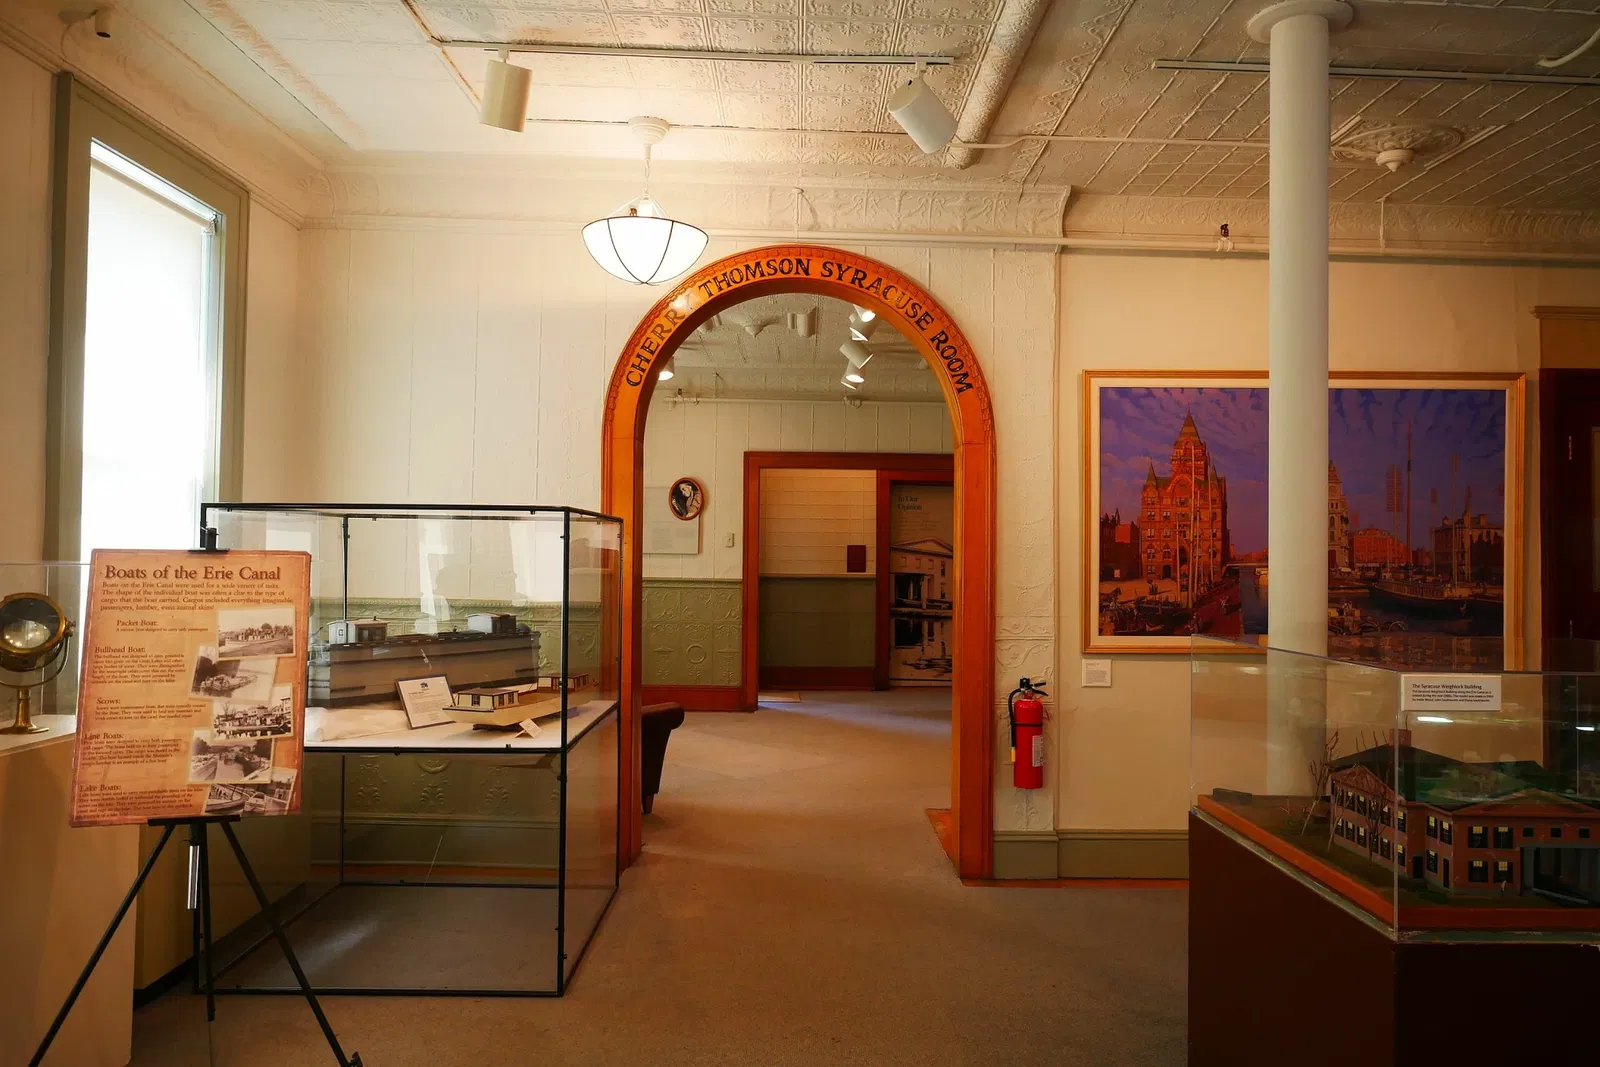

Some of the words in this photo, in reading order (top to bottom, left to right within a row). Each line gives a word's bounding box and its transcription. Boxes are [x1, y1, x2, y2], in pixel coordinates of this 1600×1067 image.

[698, 257, 811, 299] THOMSON
[820, 261, 935, 331] SYRACUSE
[929, 329, 974, 394] ROOM
[105, 565, 147, 580] Boats
[153, 565, 171, 580] of
[174, 565, 197, 580] the
[203, 566, 234, 580] Erie
[239, 566, 281, 580] Canal
[116, 589, 133, 597] shape
[116, 619, 139, 627] Packet
[96, 697, 120, 705] Scows:
[84, 733, 101, 741] Line
[103, 732, 124, 740] Boats:
